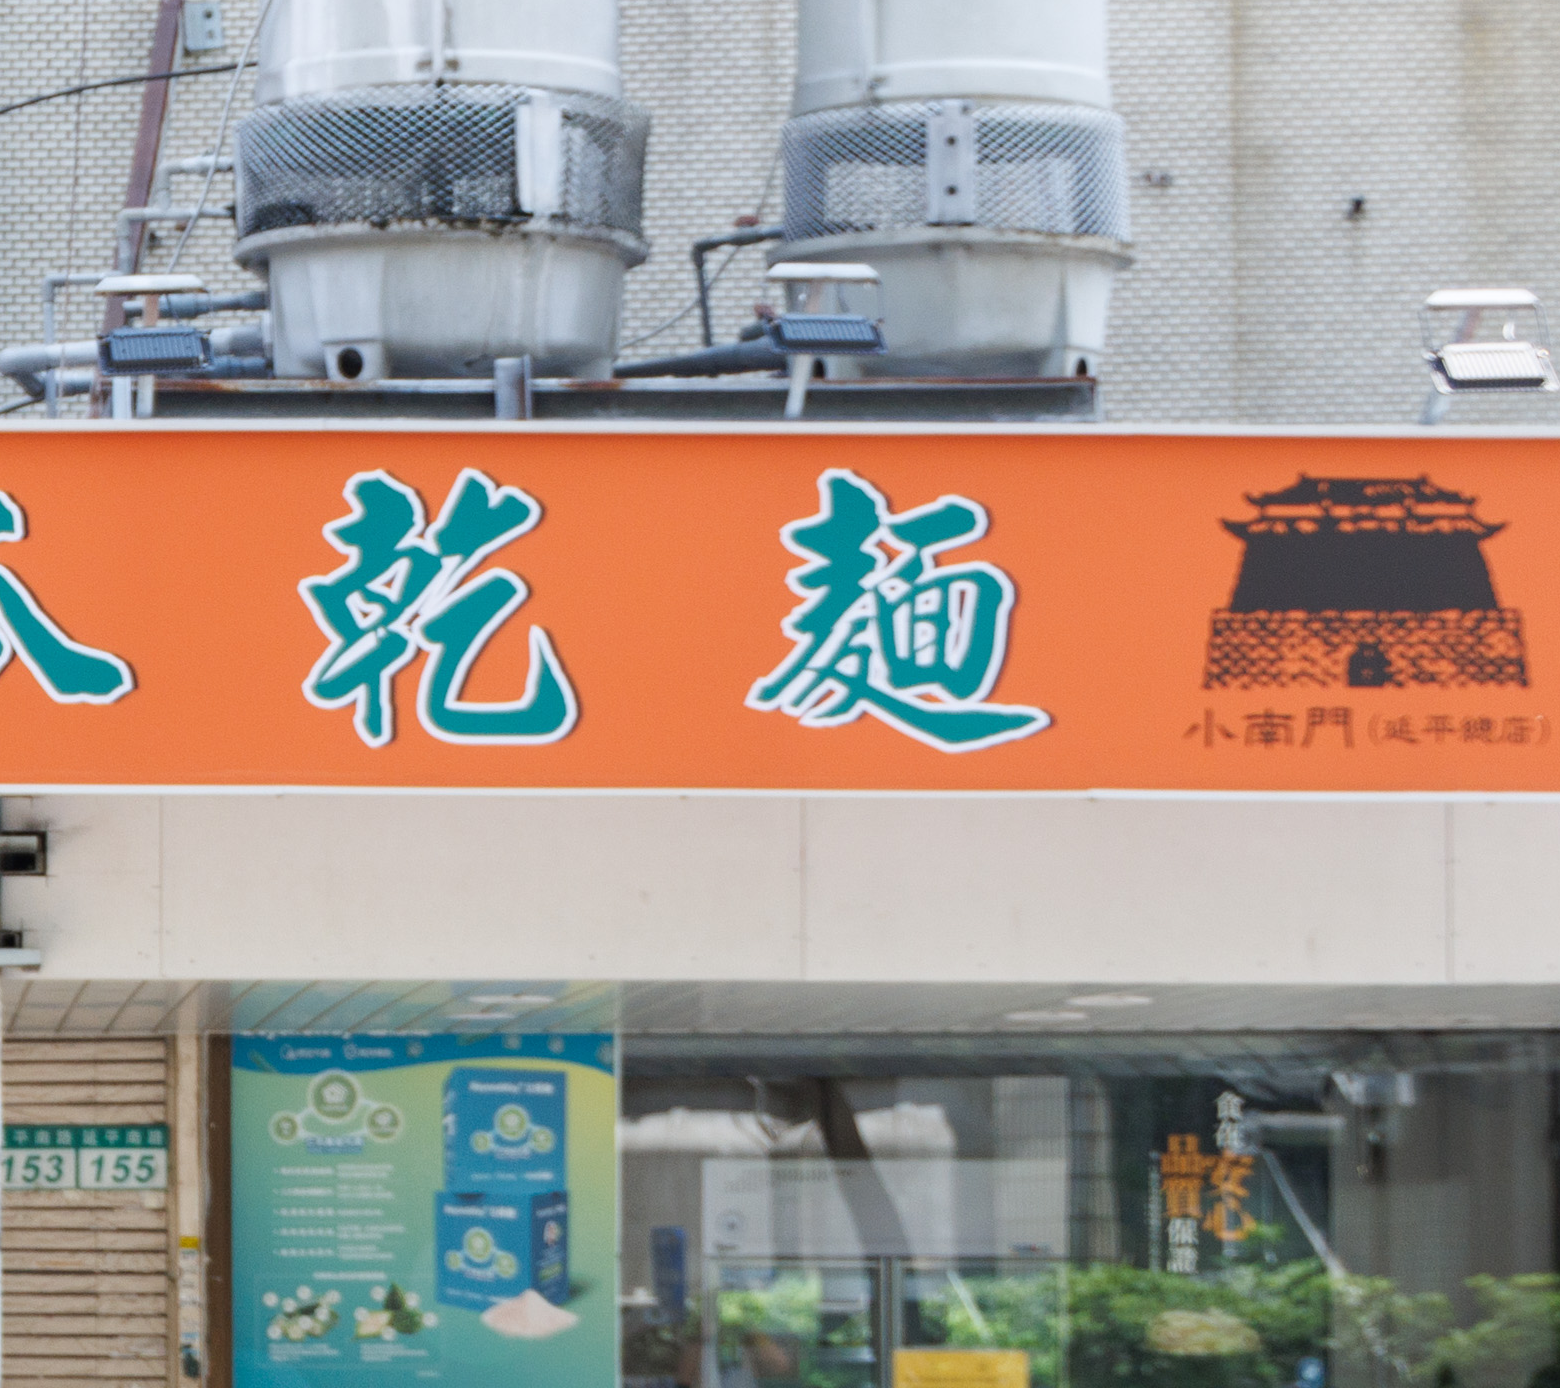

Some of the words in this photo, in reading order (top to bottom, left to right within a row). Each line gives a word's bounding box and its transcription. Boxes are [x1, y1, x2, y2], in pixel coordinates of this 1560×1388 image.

[4, 1128, 73, 1145] 平南路
[2, 1155, 64, 1183] 153
[91, 1155, 157, 1183] 155
